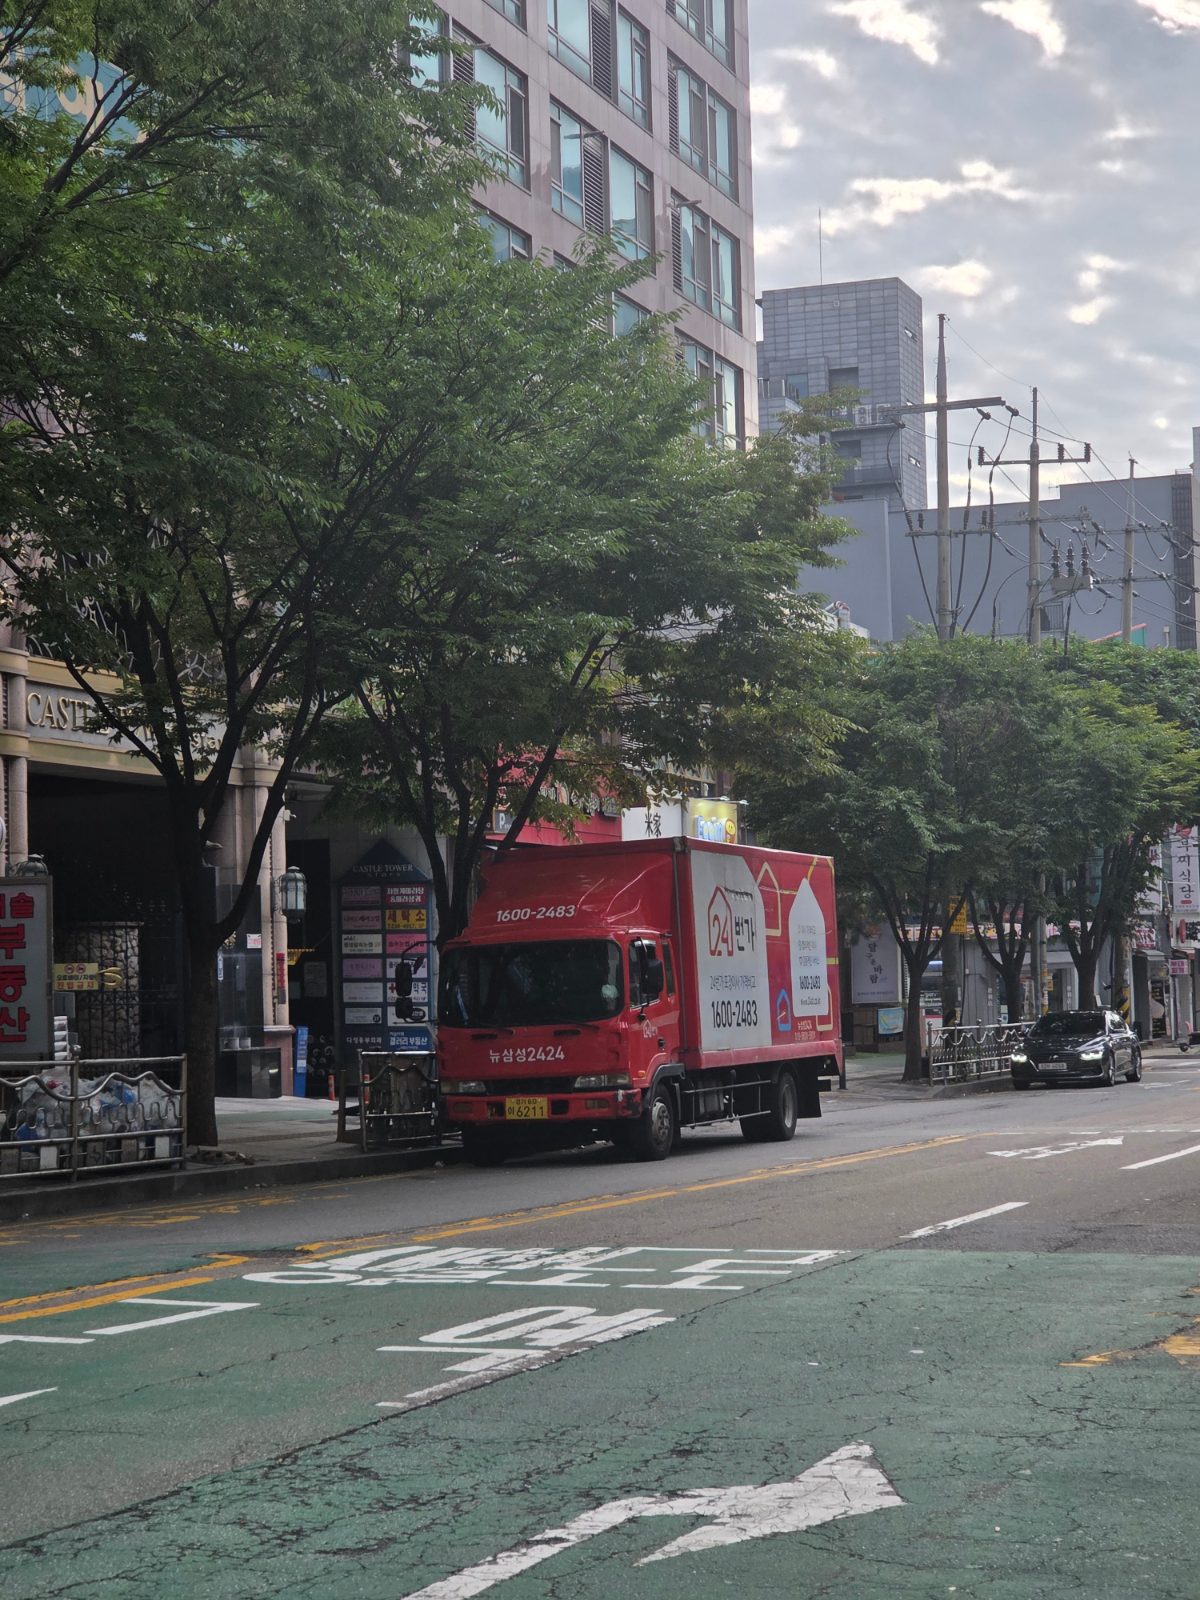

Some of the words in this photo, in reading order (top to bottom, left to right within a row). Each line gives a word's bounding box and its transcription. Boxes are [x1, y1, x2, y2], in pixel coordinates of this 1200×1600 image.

[352, 864, 383, 873] CASTLE
[384, 864, 413, 872] TOWER
[496, 904, 576, 922] 1600-2483
[799, 975, 821, 990] 1600-2483
[711, 1000, 758, 1028] 1600-2483
[489, 1046, 566, 1063] 뉴삼성2424
[516, 1105, 544, 1118] 6211
